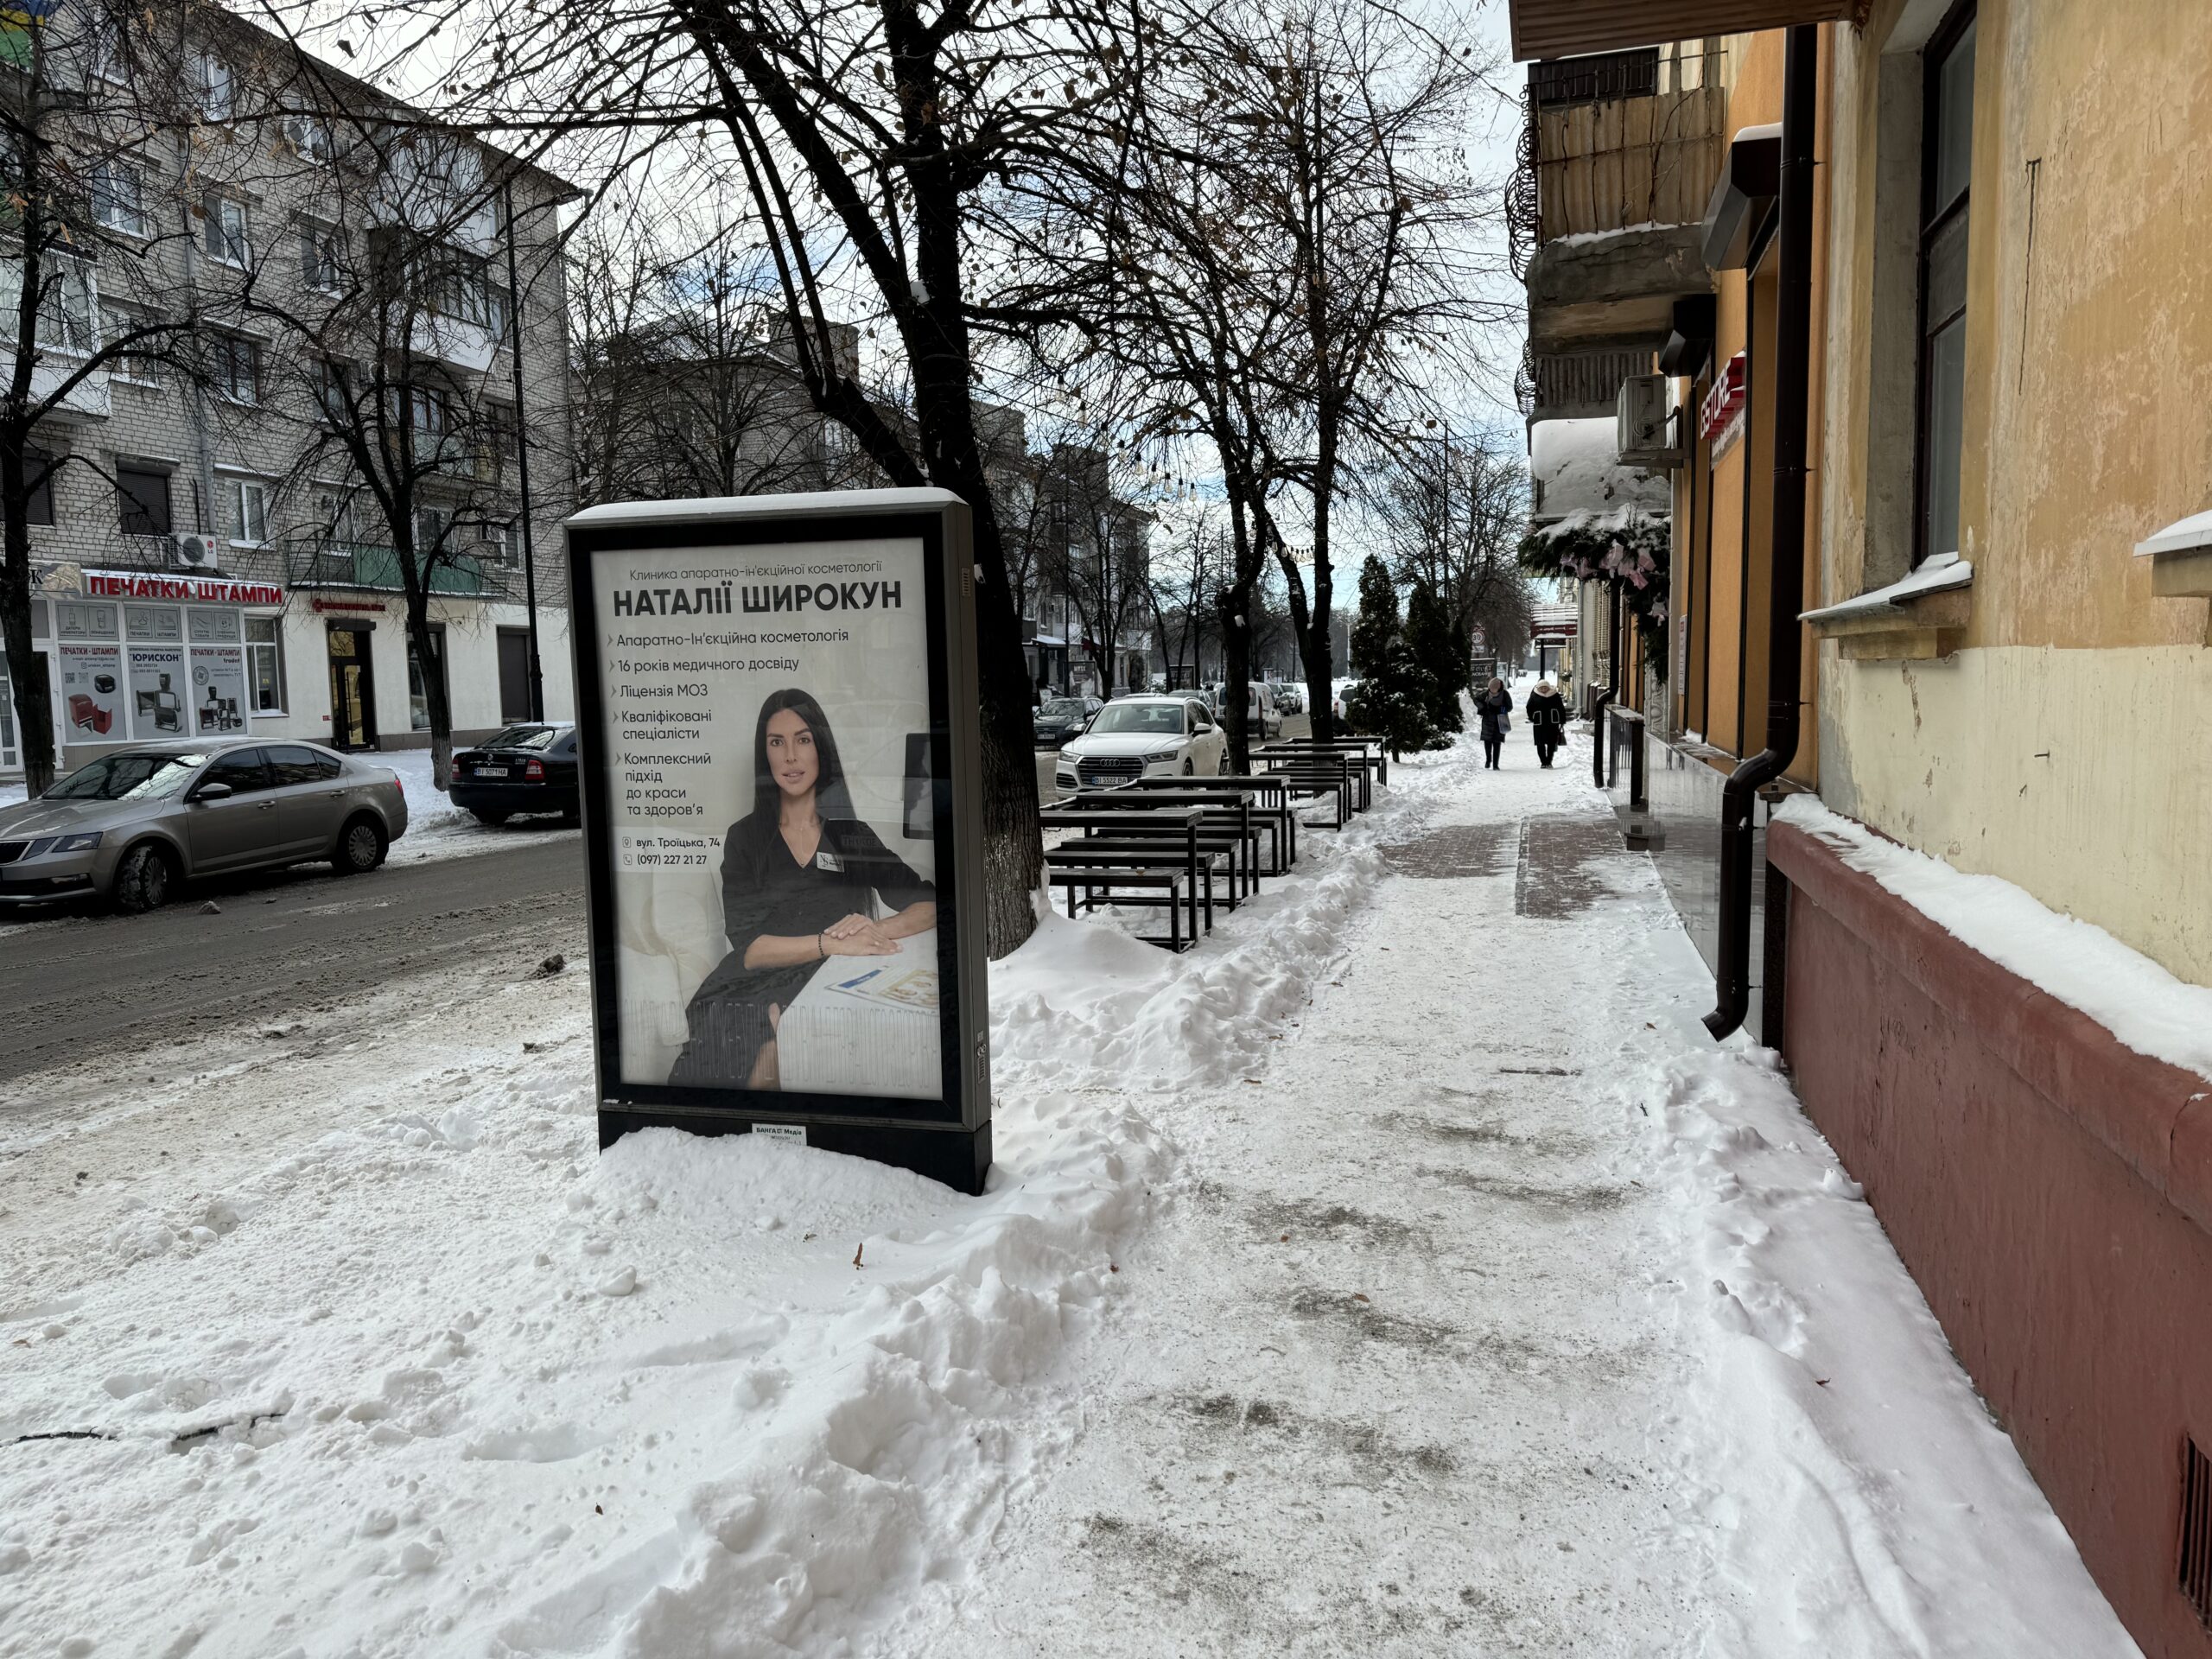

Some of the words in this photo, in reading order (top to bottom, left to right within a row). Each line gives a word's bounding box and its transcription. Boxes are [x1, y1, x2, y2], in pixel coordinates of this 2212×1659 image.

[630, 569, 677, 581] Клиника
[808, 561, 883, 575] косметології
[90, 576, 189, 599] ПЕЧАТКИ
[198, 583, 283, 603] ШТАМПИ
[613, 580, 733, 616] НАТАЛІЇ
[742, 581, 902, 613] ШИРОКУН
[760, 630, 849, 645] косметологія
[60, 646, 88, 655] ПЕЧАТКИ
[618, 660, 631, 673] 16
[634, 659, 669, 674] років
[673, 659, 745, 672] медичного
[748, 657, 799, 672] досвіду
[620, 685, 673, 699] Ліцензія
[677, 684, 709, 697] МОЗ
[622, 709, 712, 725] Кваліфіковані
[623, 728, 700, 741] спеціалісти
[625, 753, 711, 765] Комплексний
[626, 770, 663, 783] підхід
[626, 789, 641, 800] до
[645, 788, 686, 801] краси
[627, 806, 641, 816] та
[645, 804, 703, 818] здоров'я
[637, 838, 655, 849] вул.
[658, 837, 707, 849] Троїцька,
[709, 837, 721, 848] 74
[638, 854, 661, 865] (097)
[664, 855, 680, 865] 227
[683, 854, 694, 865] 21
[696, 855, 707, 865] 27
